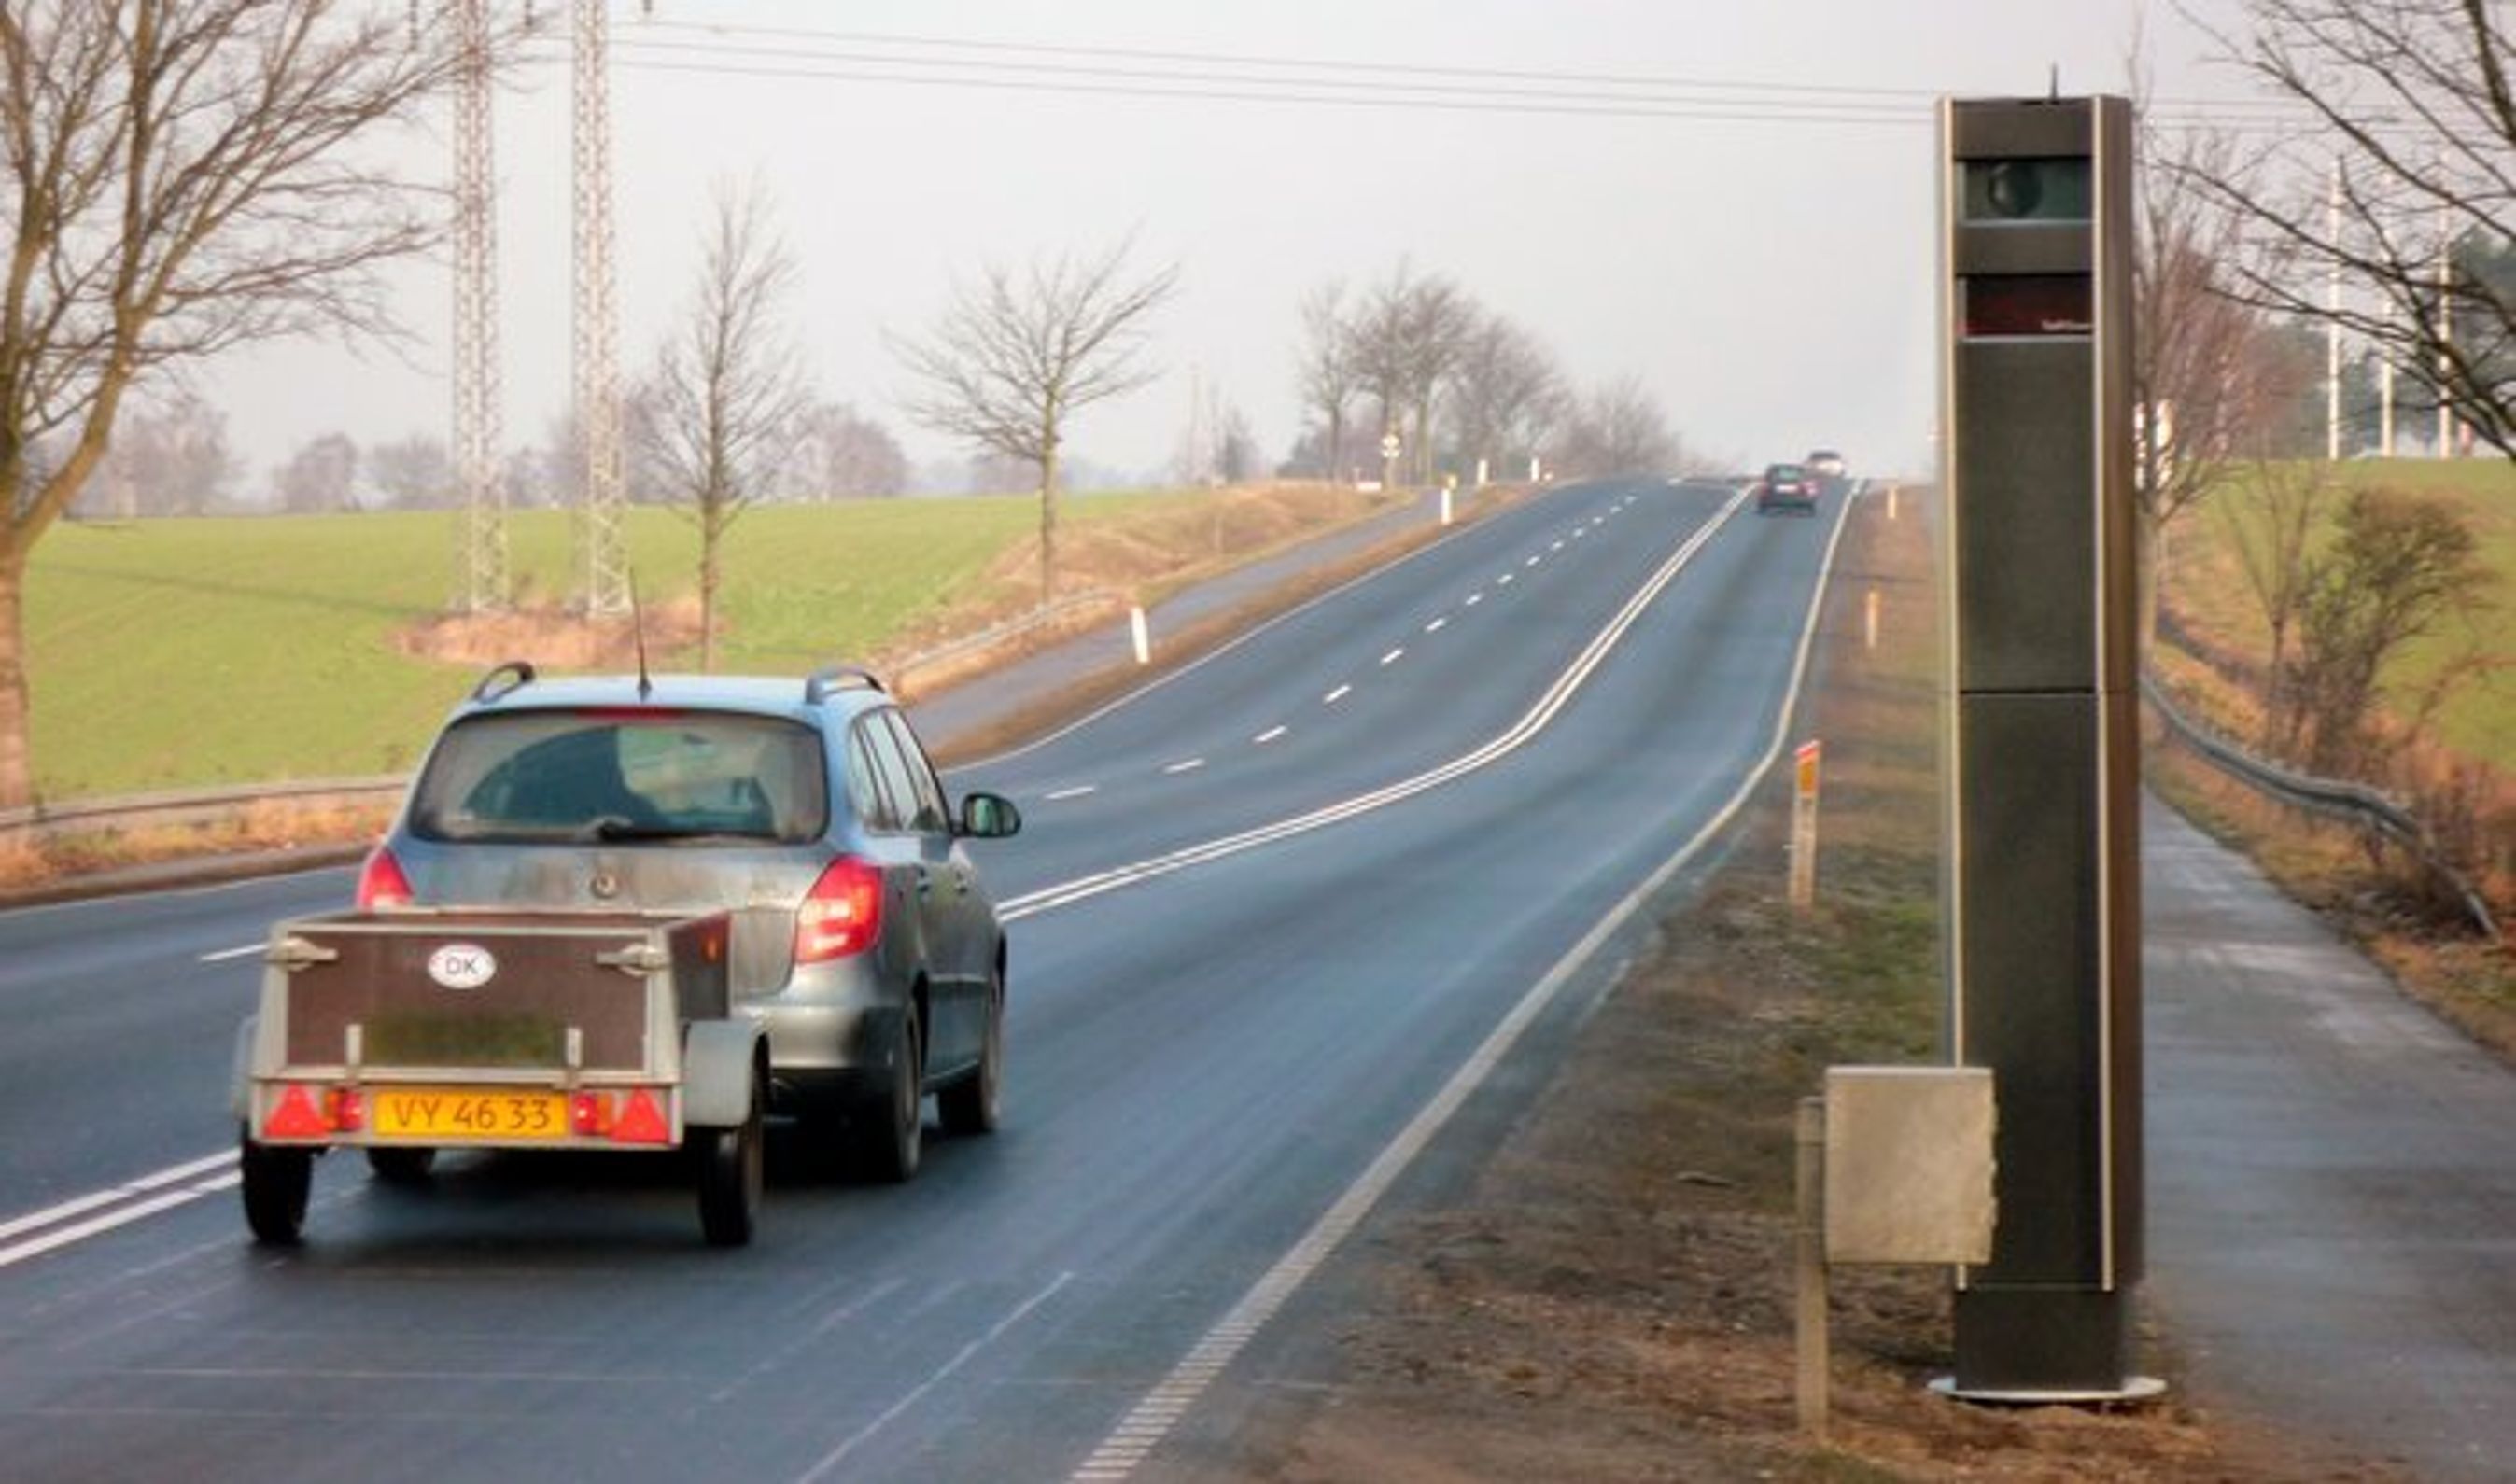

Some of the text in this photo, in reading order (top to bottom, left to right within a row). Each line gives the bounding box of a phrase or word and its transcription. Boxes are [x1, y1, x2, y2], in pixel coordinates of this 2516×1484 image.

[445, 956, 479, 975] DK
[392, 1098, 551, 1129] VY 46 33
